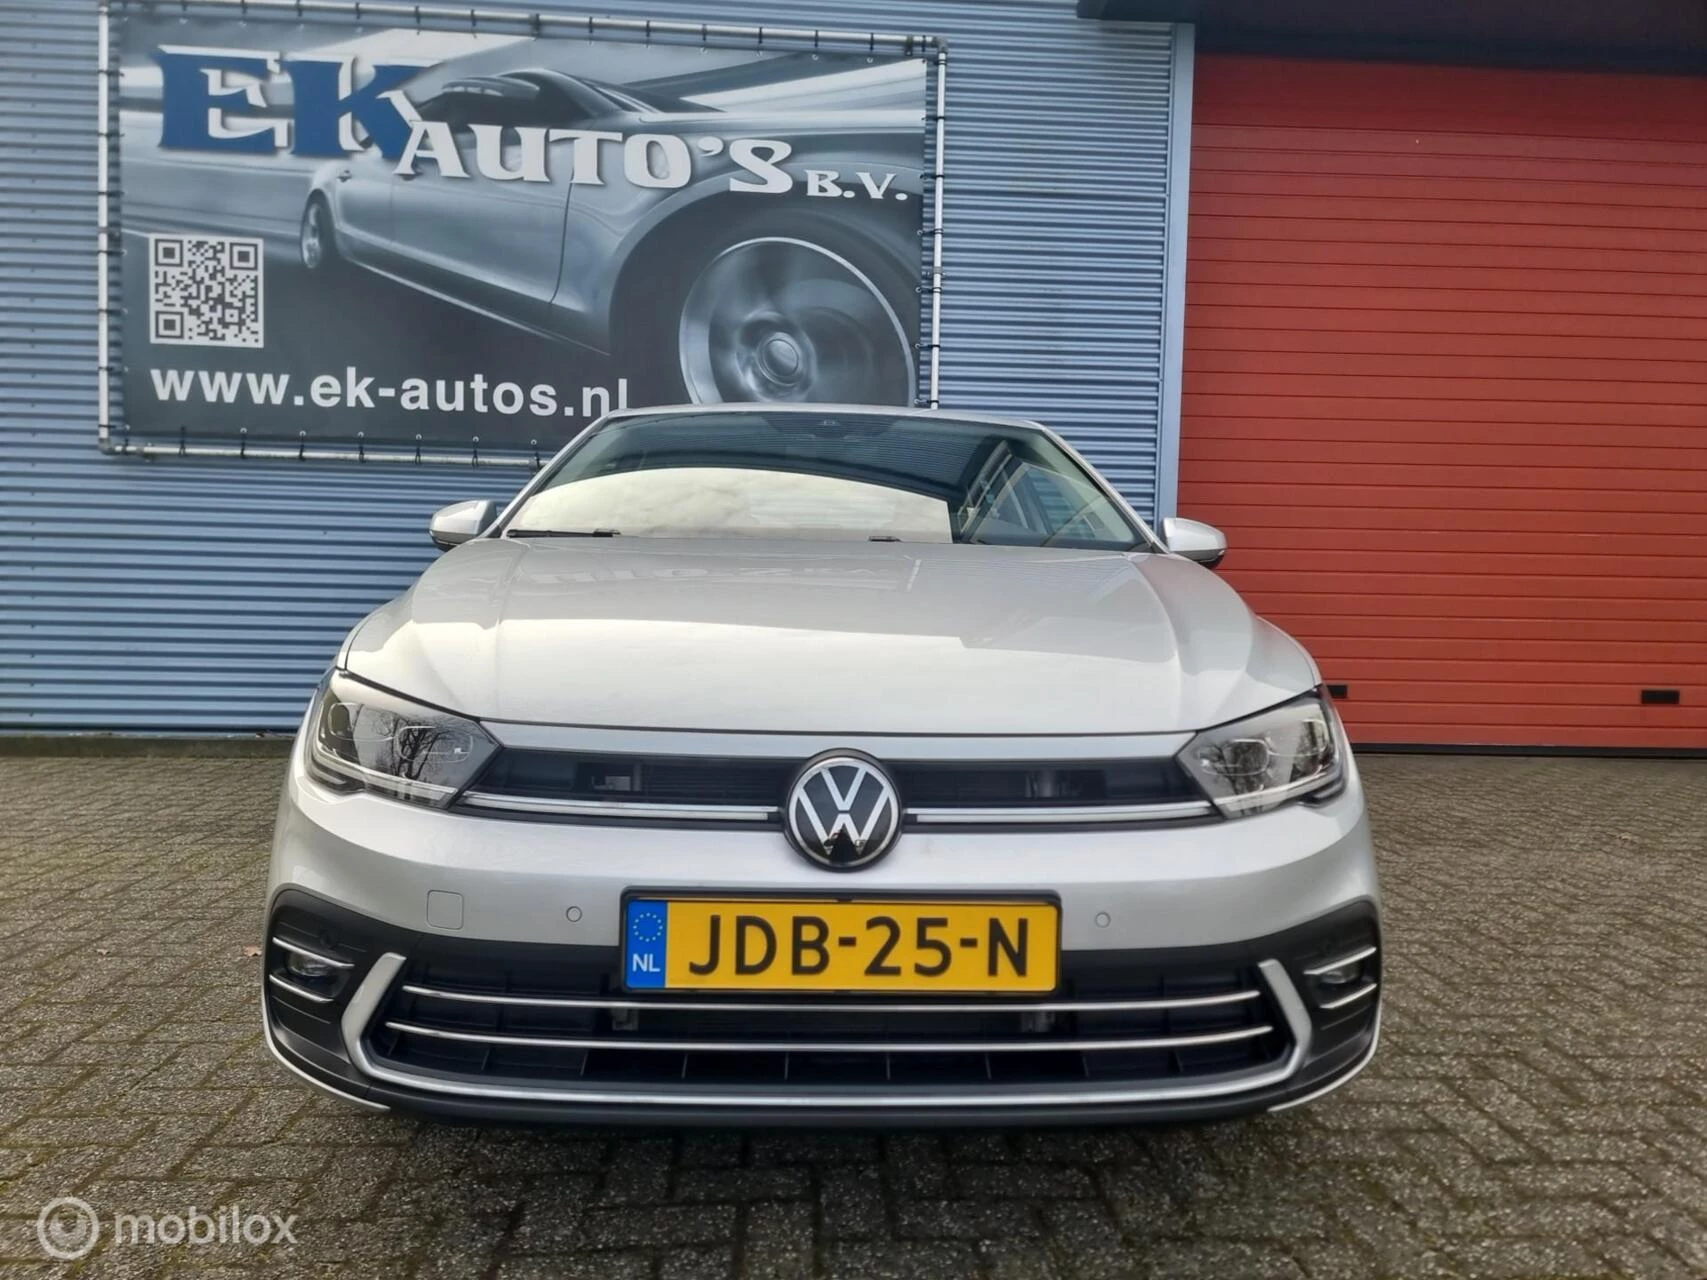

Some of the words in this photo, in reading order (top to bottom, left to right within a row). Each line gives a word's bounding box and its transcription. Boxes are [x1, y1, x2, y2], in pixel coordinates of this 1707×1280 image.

[157, 44, 423, 161] EK
[806, 169, 908, 201] B.V.
[150, 366, 628, 418] www.ek-autos.nl
[795, 763, 893, 859] VW
[632, 953, 661, 973] NL
[688, 914, 1029, 978] JDB-25-N
